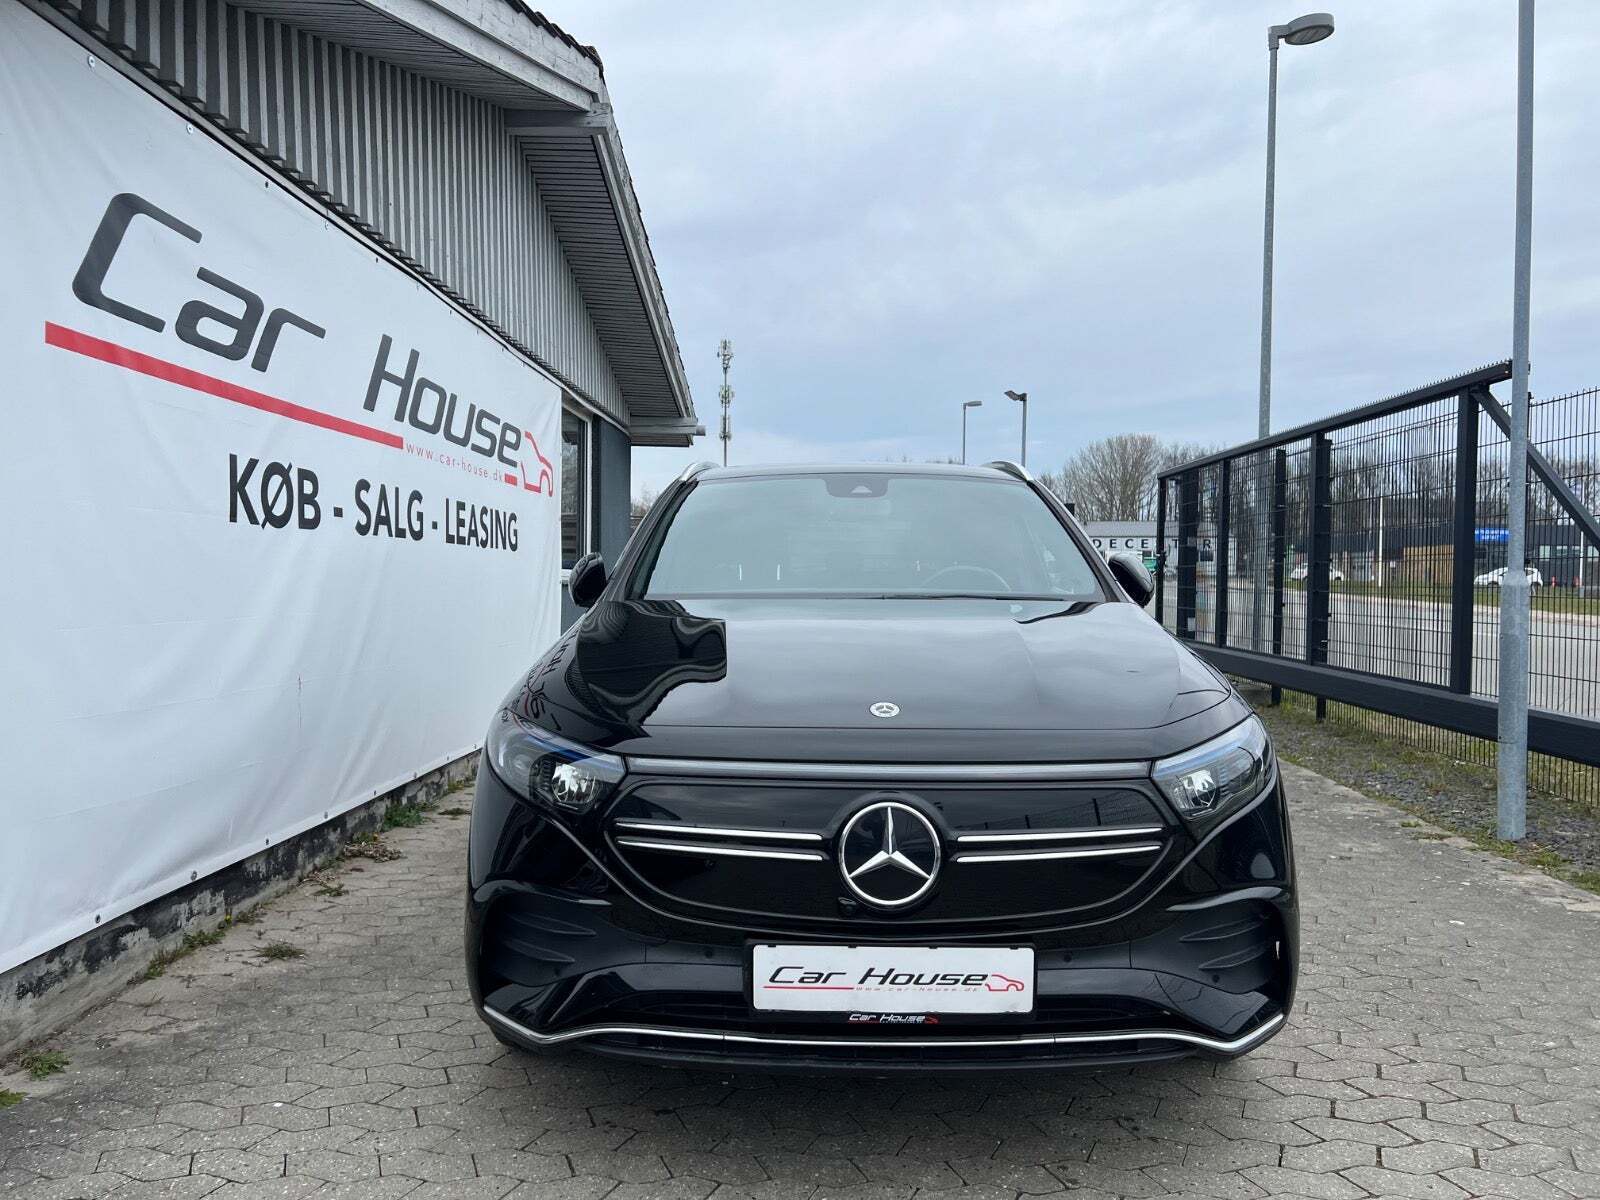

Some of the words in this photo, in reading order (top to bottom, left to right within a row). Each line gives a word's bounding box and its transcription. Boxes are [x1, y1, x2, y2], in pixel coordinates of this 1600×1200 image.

[72, 193, 326, 372] Car
[363, 334, 522, 469] House
[229, 453, 322, 530] KØB
[354, 478, 424, 541] SALG
[445, 498, 518, 552] LEASING
[768, 966, 847, 984] Car
[858, 967, 989, 986] House
[849, 1013, 877, 1021] Car
[879, 1013, 926, 1022] House
